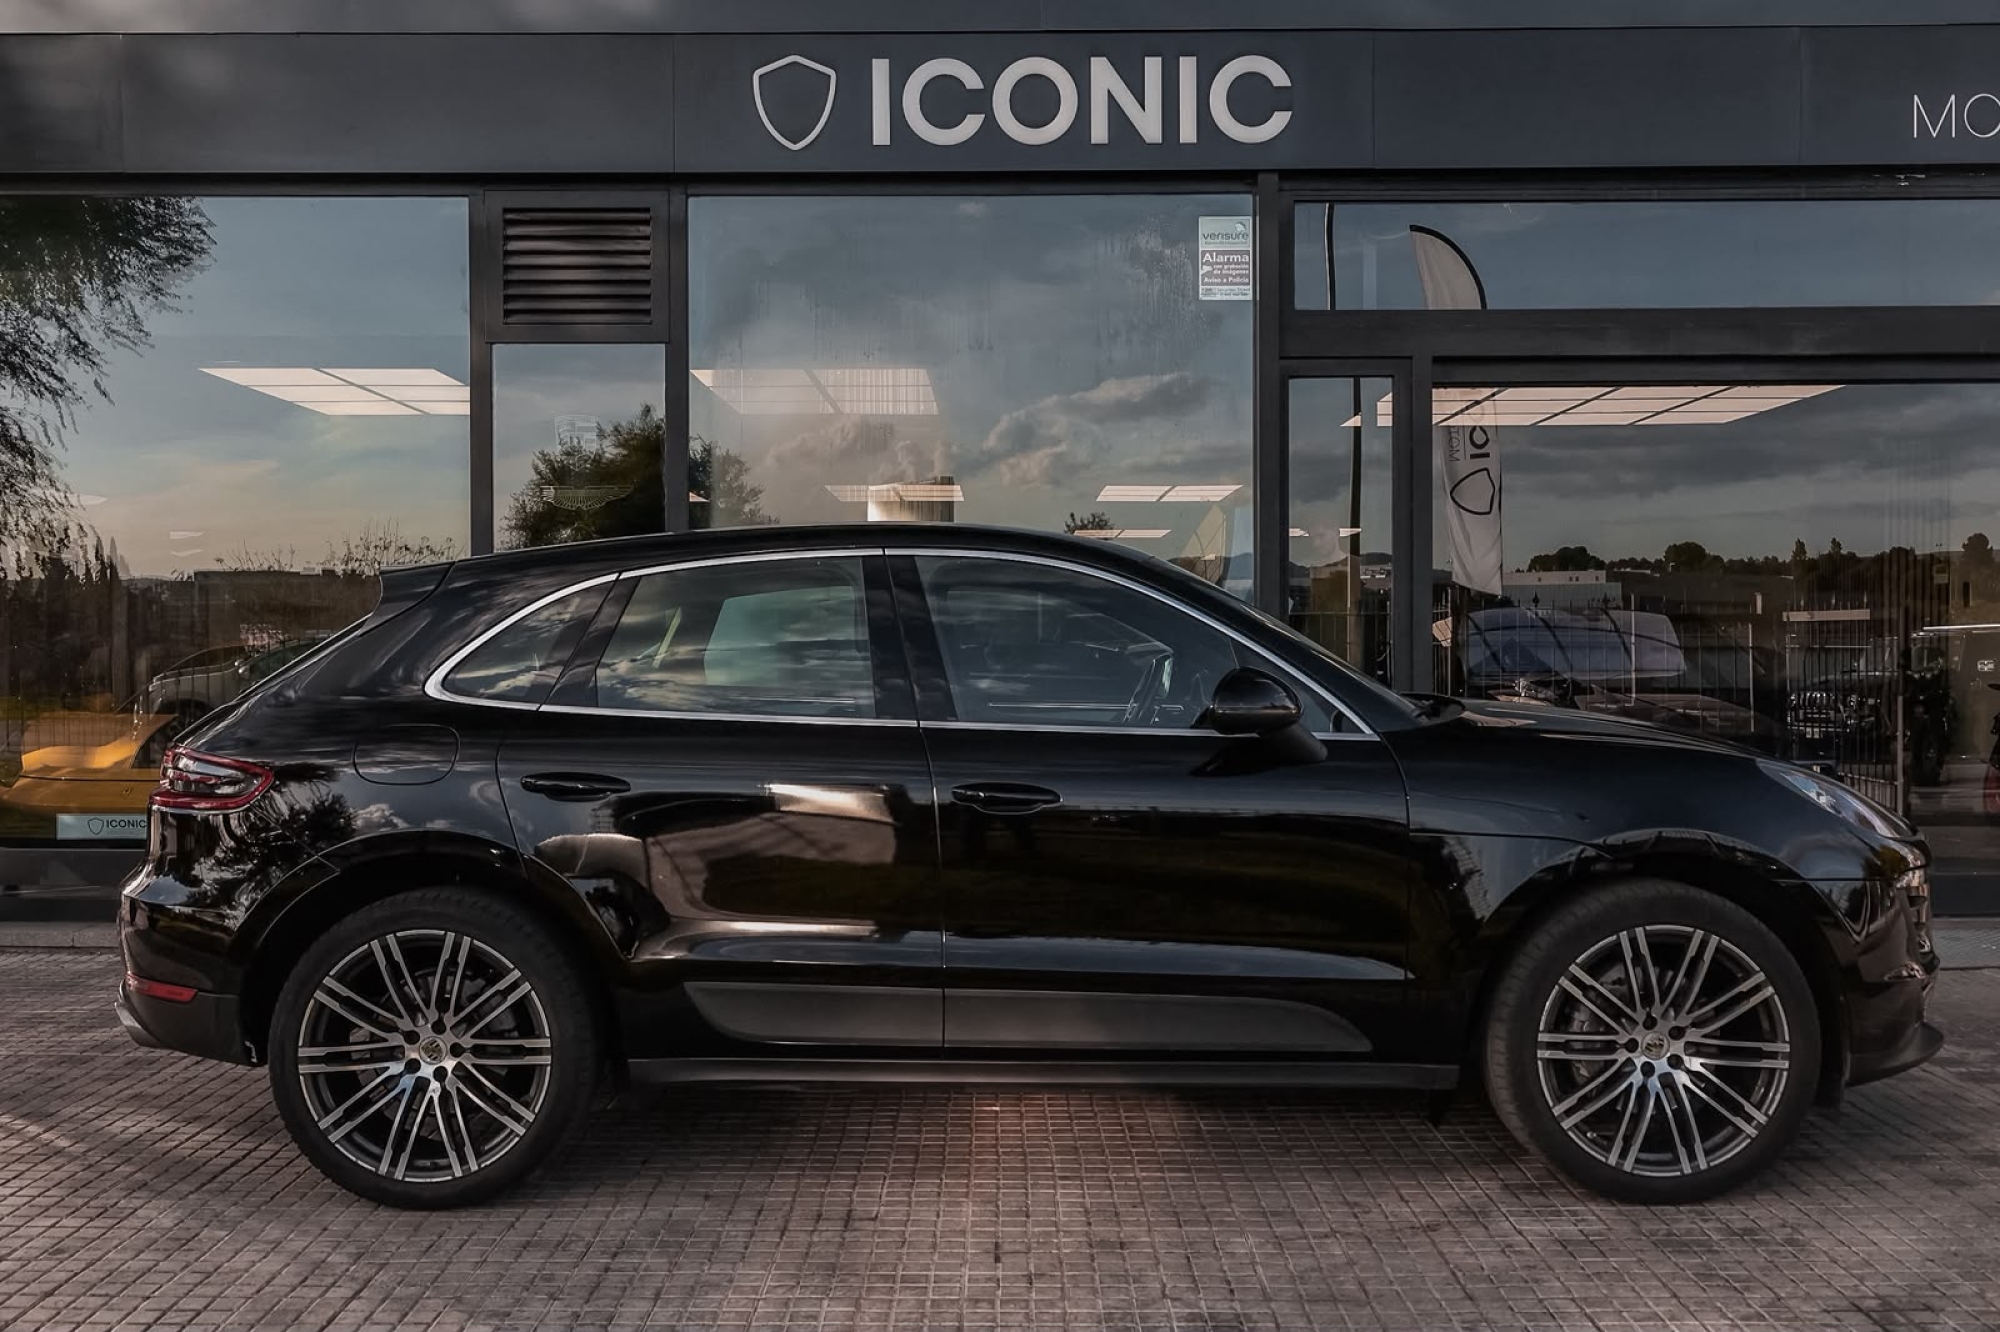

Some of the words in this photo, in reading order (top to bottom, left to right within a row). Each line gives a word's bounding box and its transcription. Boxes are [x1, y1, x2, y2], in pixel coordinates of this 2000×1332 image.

[872, 55, 1292, 145] ICONIC
[1202, 252, 1249, 262] Alarma
[106, 820, 147, 828] ICONIC
